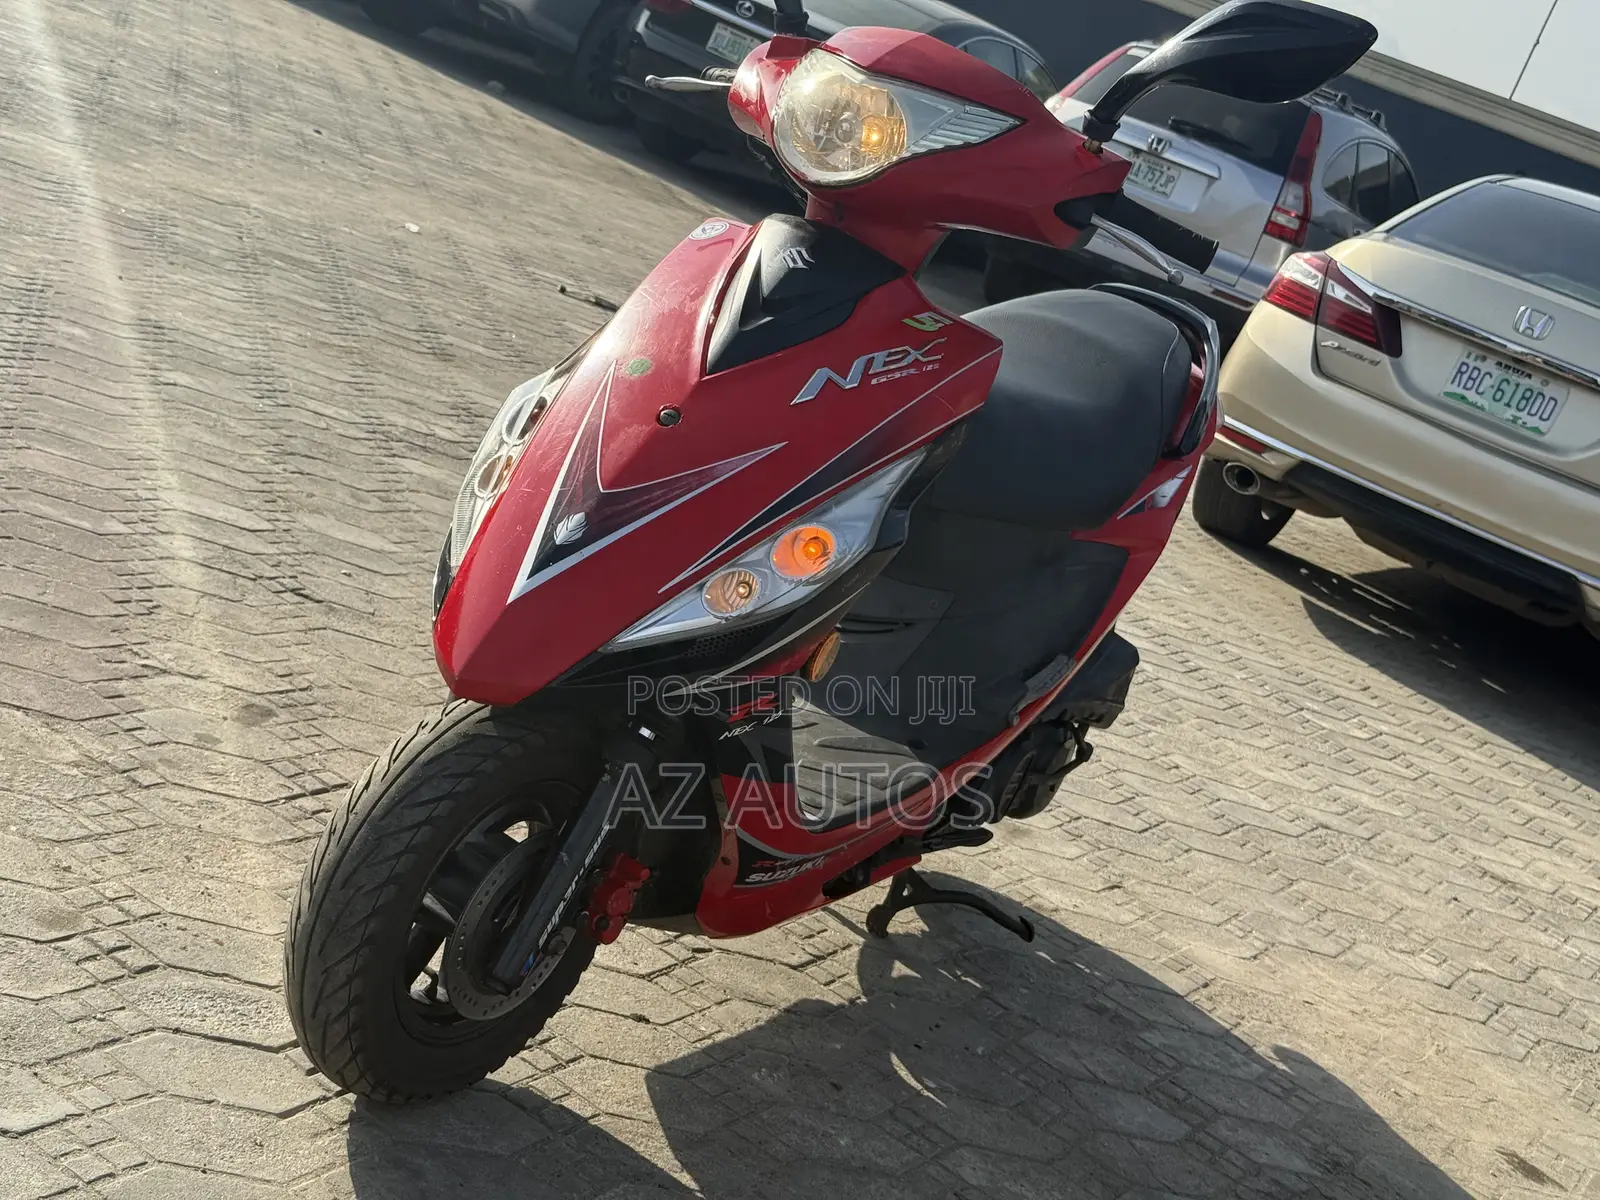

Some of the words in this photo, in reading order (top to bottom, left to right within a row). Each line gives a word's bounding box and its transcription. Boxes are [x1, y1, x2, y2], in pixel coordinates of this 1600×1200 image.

[790, 337, 947, 405] NEX
[1450, 360, 1558, 422] RBC-618DD
[718, 721, 758, 740] NEX
[744, 855, 826, 882] SUZUKI
